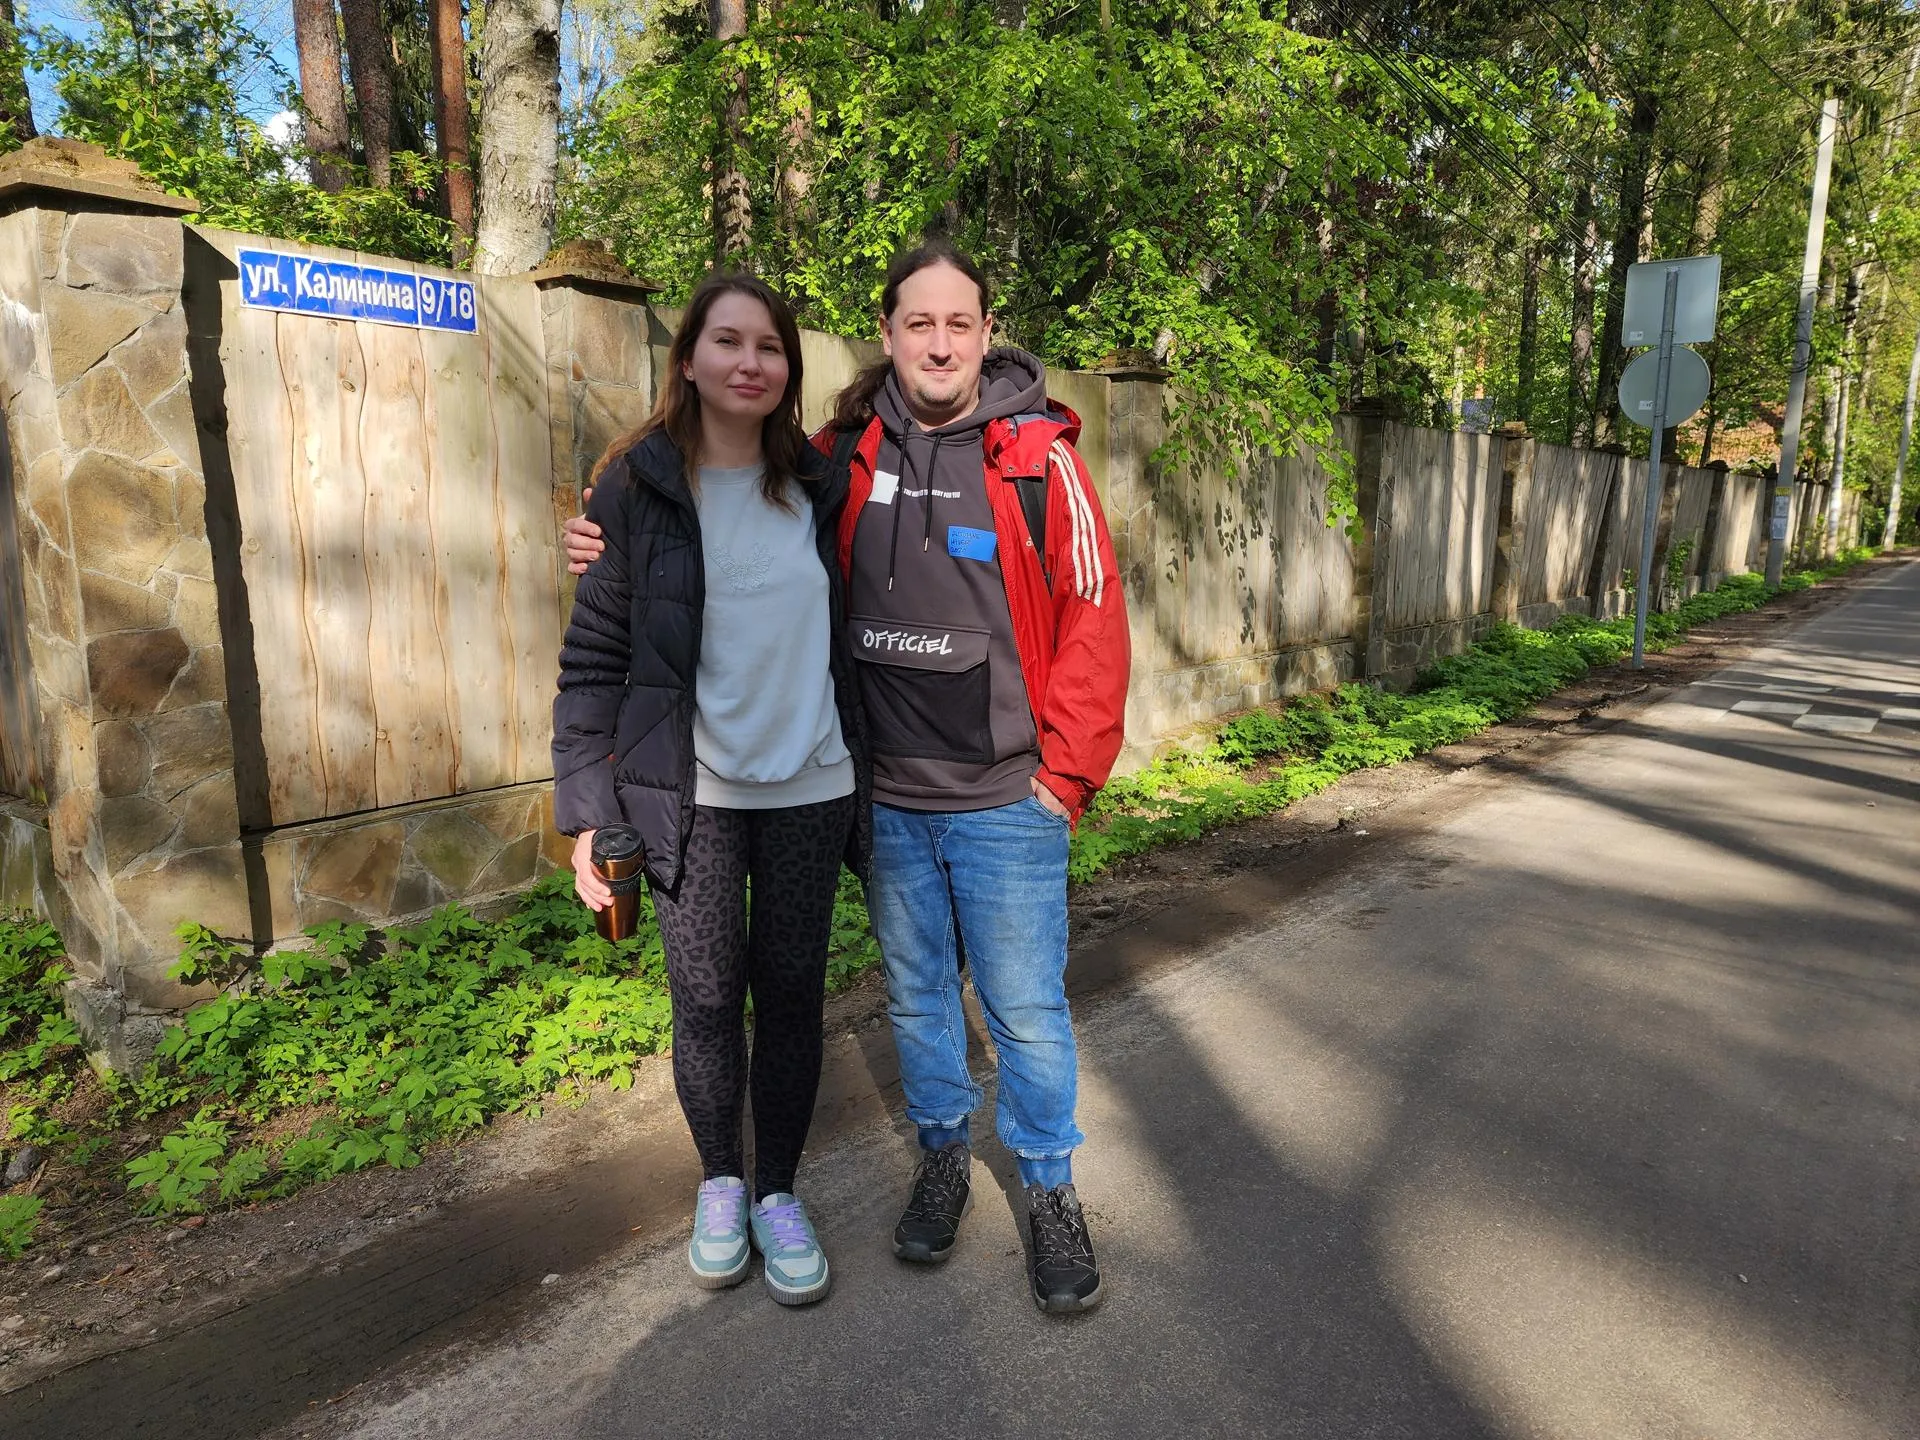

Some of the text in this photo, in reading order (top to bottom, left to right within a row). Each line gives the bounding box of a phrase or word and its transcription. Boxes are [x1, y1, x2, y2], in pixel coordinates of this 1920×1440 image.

[245, 261, 474, 323] ул. Калинина 9/18
